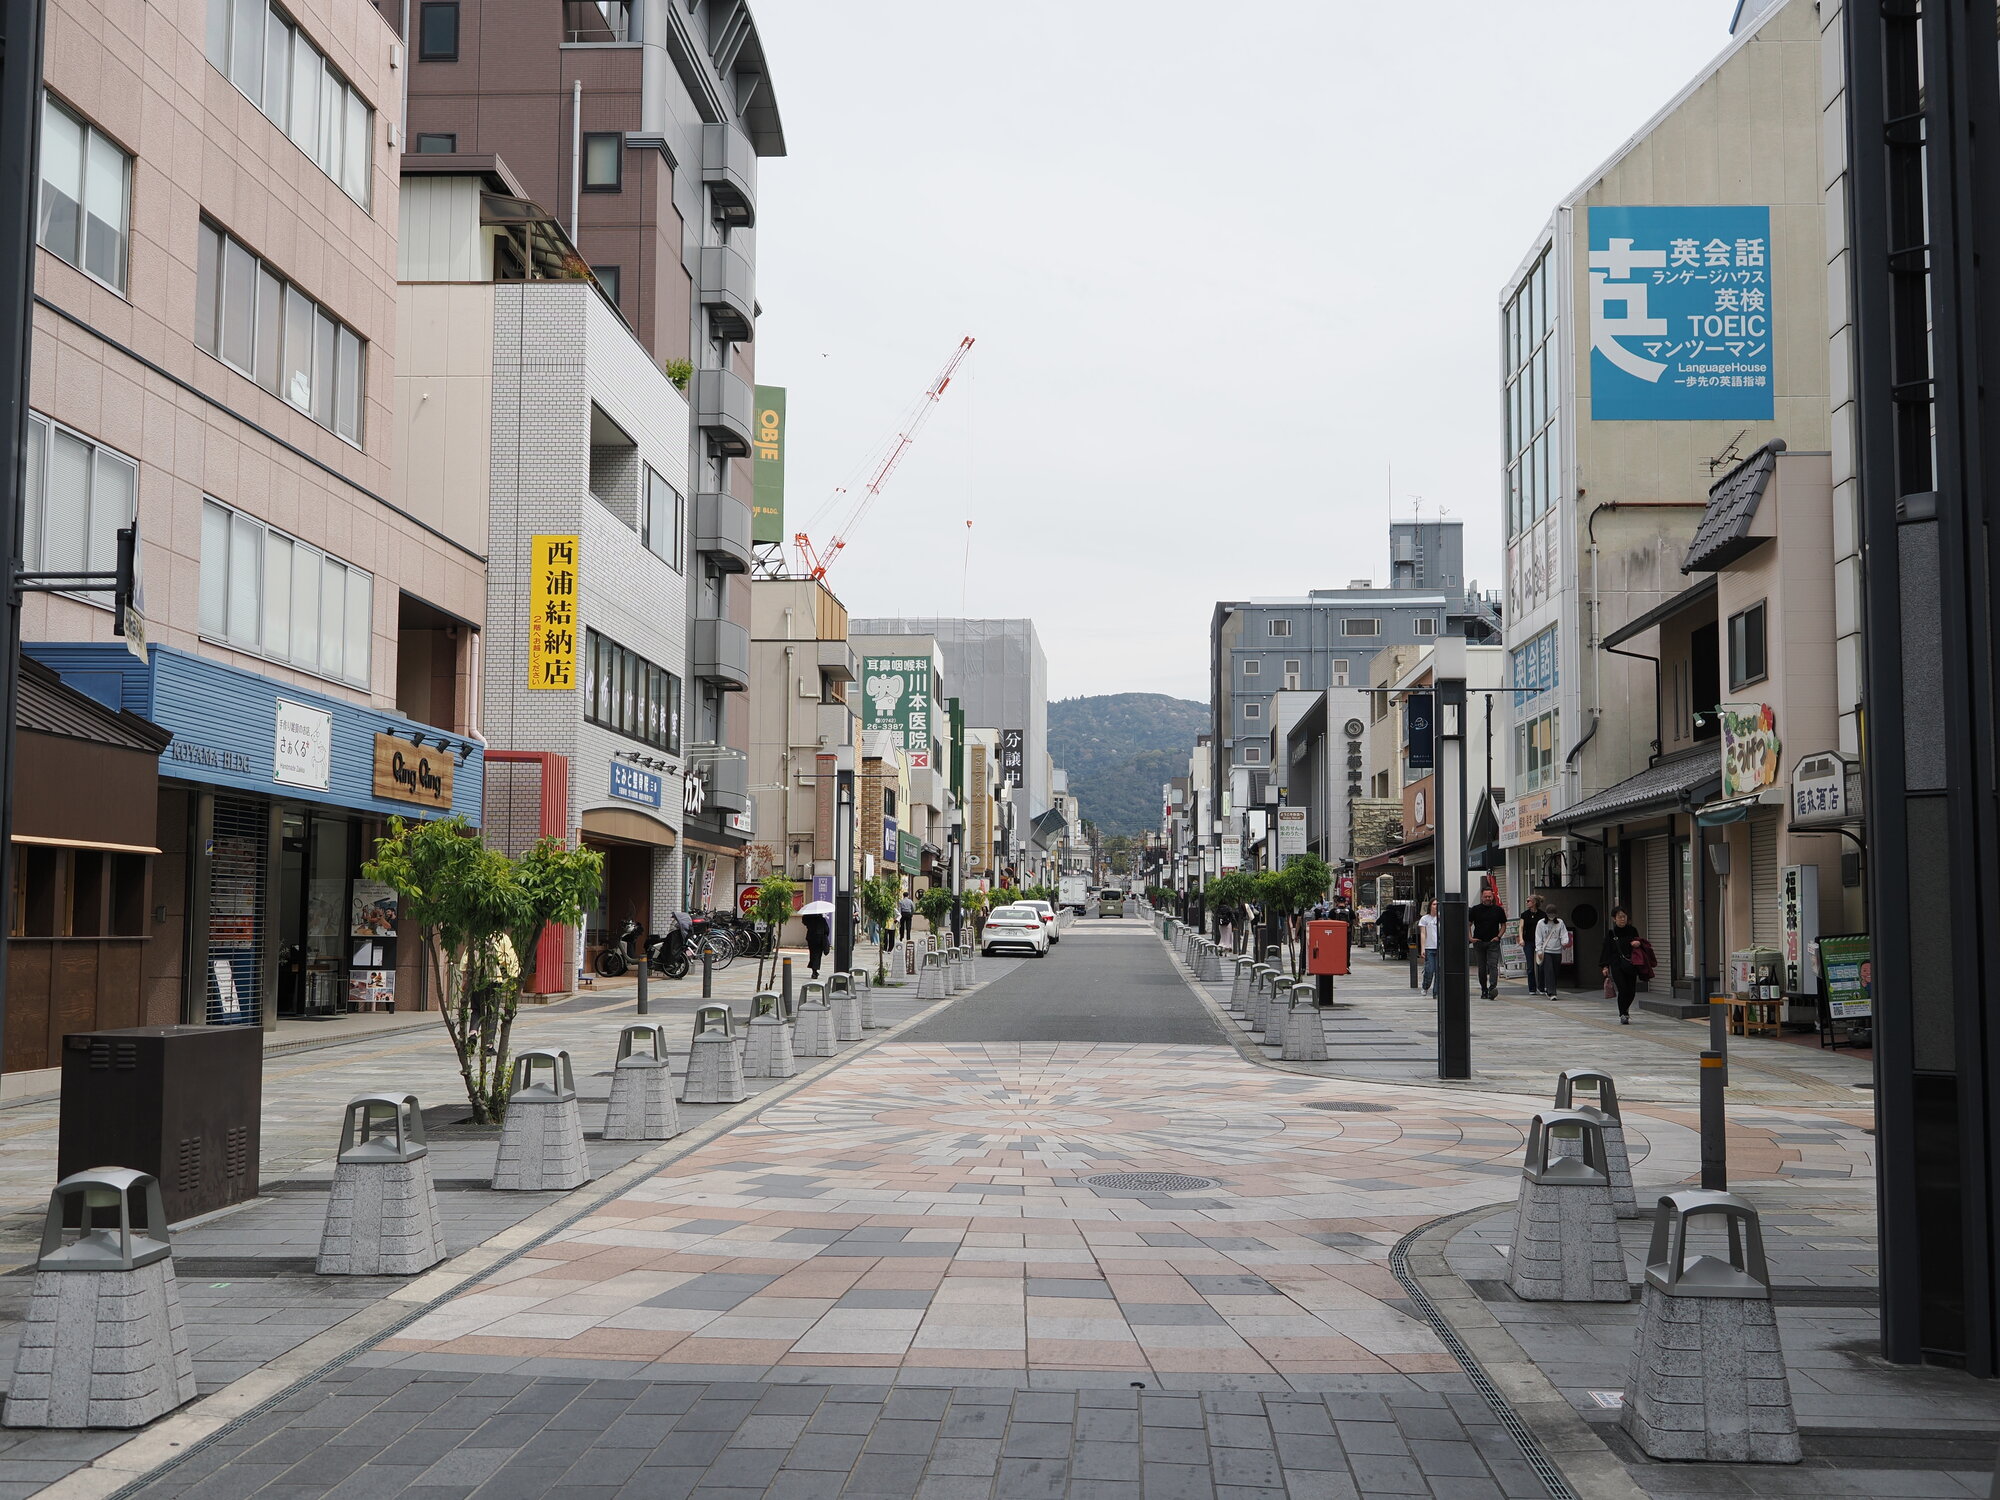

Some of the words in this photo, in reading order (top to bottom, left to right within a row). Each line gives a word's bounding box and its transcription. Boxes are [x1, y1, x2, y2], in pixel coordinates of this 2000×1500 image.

[1670, 238, 1765, 267] 英会話
[1652, 270, 1765, 284] ランゲージハウス
[1714, 288, 1765, 312] 英検
[1688, 315, 1766, 337] TOEIC
[1643, 341, 1766, 358] マンツーマン
[1678, 362, 1767, 373] LanguageHouse
[1674, 376, 1766, 387] 一歩先の英語指導
[754, 409, 779, 460] OBJE
[544, 541, 573, 684] 西浦結納店
[867, 660, 927, 672] 耳鼻咽喉科
[1515, 637, 1551, 692] 英会話
[908, 673, 927, 749] 川本医院
[279, 719, 310, 736] 手作り雑貨のお店
[173, 741, 220, 768] KOYAMA
[1005, 732, 1022, 785] 分譲中
[1786, 871, 1798, 992] 福森酒店
